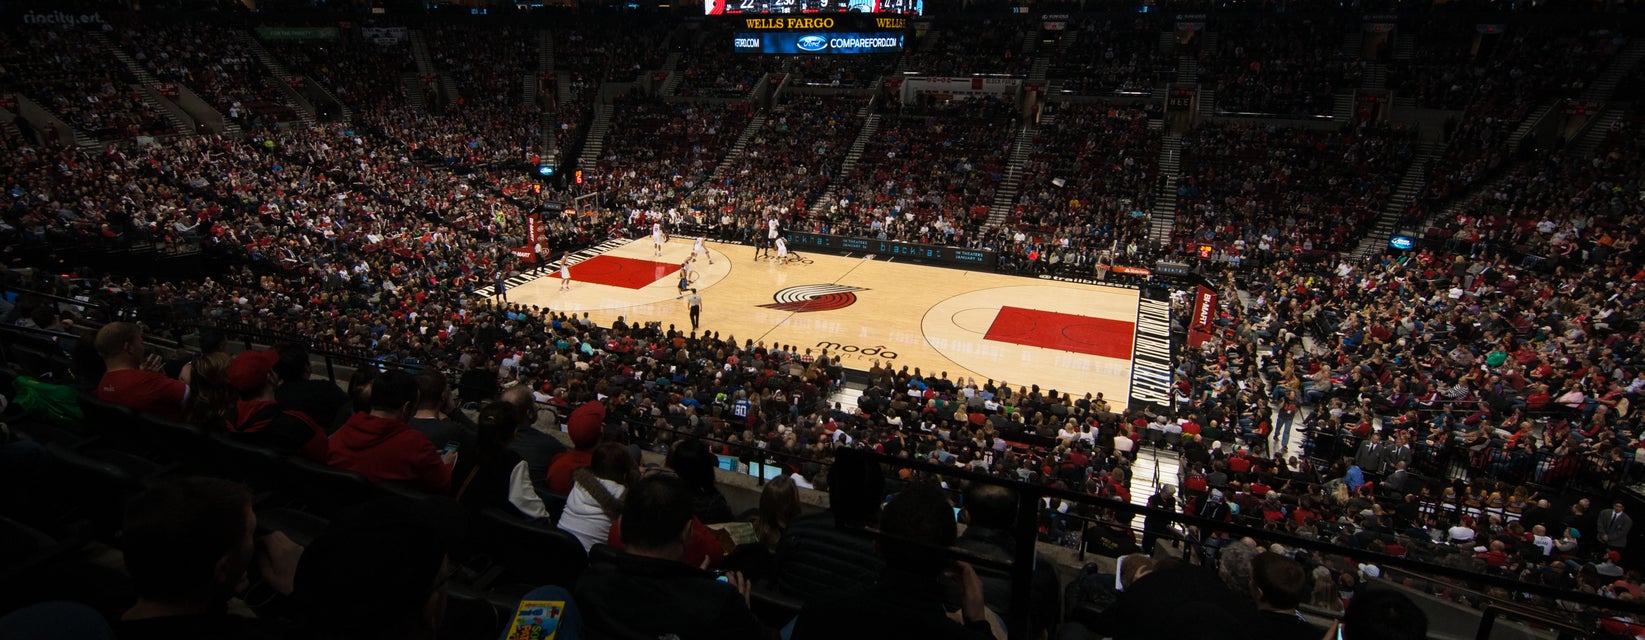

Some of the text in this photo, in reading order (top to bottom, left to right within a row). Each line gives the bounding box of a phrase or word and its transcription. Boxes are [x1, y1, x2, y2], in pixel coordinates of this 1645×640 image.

[746, 18, 834, 29] WELLS FARGO
[830, 38, 897, 48] COMPAREFORD.COM
[1199, 293, 1212, 326] BI-MART
[816, 341, 898, 359] moda
